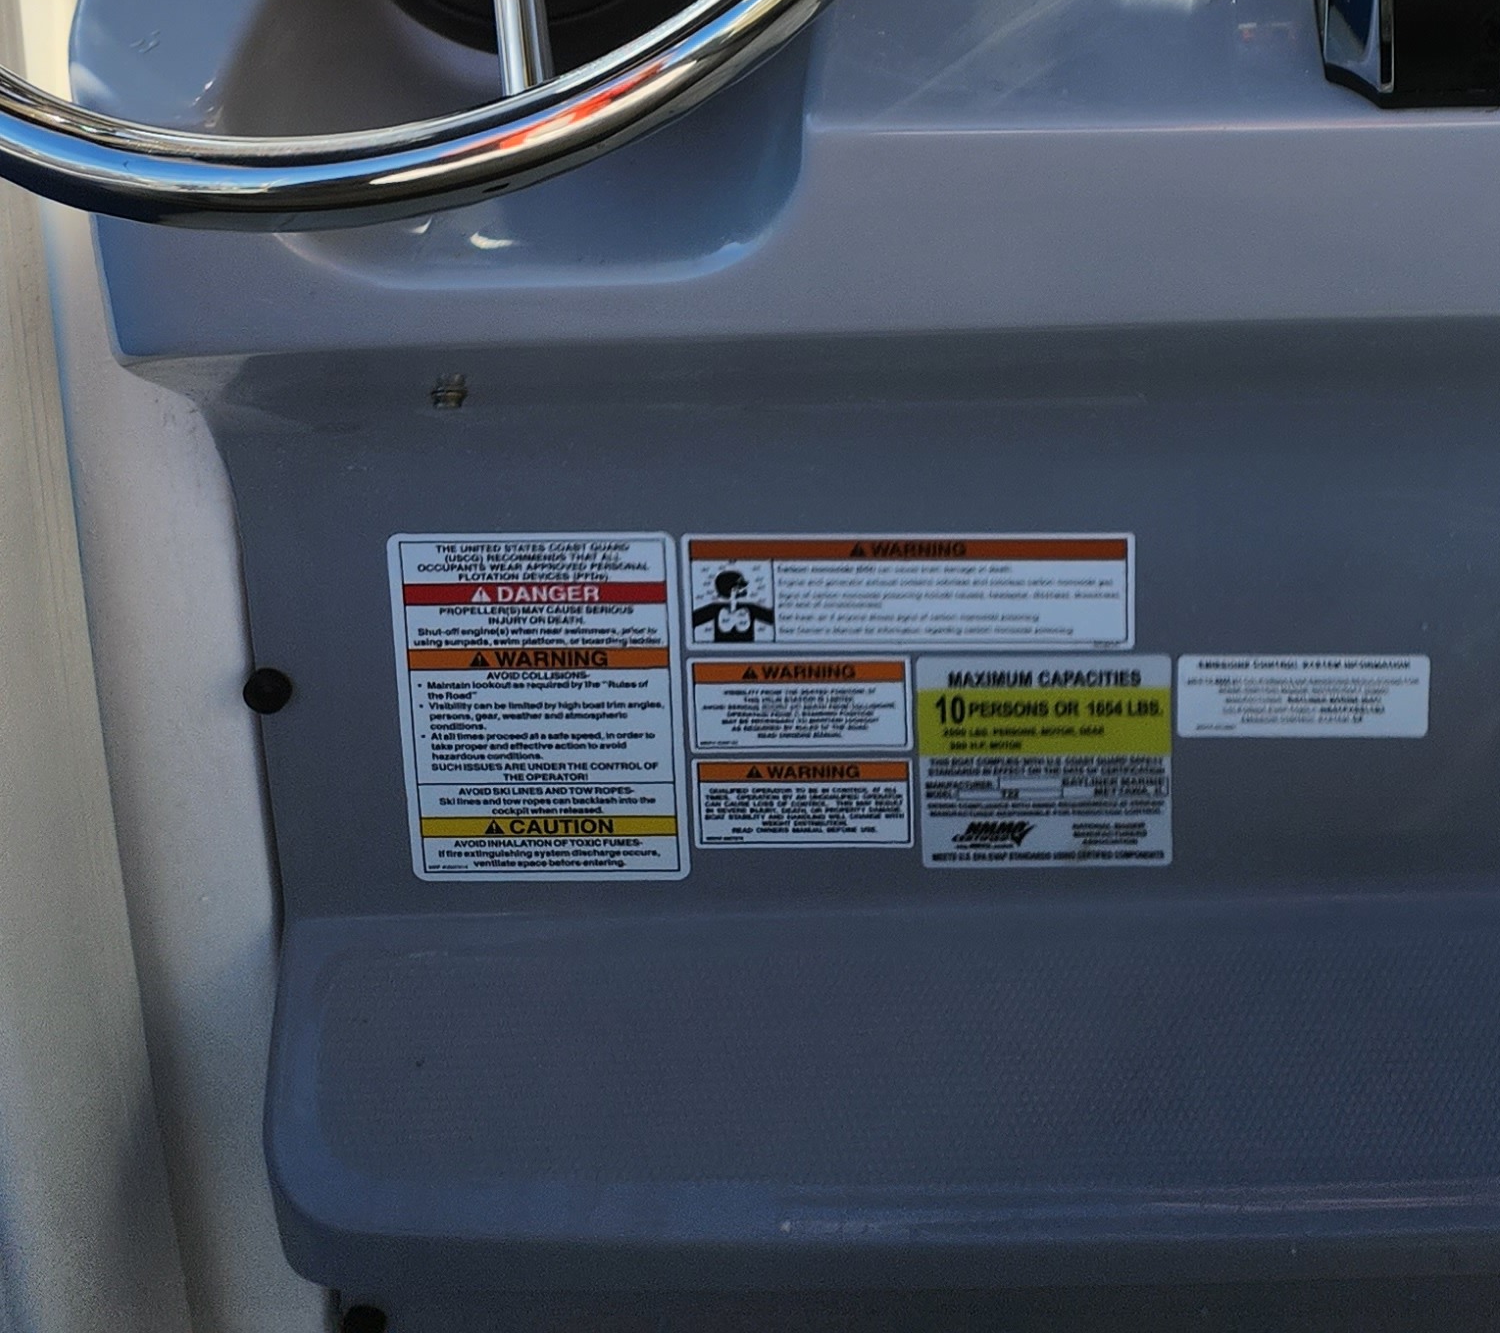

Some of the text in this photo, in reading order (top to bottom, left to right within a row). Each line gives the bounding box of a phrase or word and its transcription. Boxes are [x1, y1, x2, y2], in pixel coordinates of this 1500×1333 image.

[436, 545, 457, 553] THE
[459, 545, 501, 553] UNITED
[872, 542, 966, 557] WARNING
[497, 586, 600, 603] DANGER
[522, 607, 544, 615] MAY
[546, 606, 583, 615] CAUSE
[488, 616, 527, 625] INJURY
[495, 651, 608, 668] WARNING
[762, 665, 856, 680] WARNING
[947, 669, 1142, 688] MAXIMUM CAPACITIES
[936, 694, 966, 724] 10
[968, 700, 1050, 718] PERSONS
[1054, 700, 1079, 717] OR
[1128, 699, 1164, 717] LBS.
[432, 763, 461, 771] SUCH
[527, 762, 566, 770] UNDER
[567, 762, 588, 770] THE
[590, 762, 642, 770] CONTROL
[643, 762, 659, 770] OF
[767, 765, 861, 780] WARNING
[503, 773, 524, 781] THE
[459, 787, 491, 795] AVOID
[492, 787, 510, 795] SKI
[512, 787, 543, 795] LINES
[544, 787, 567, 795] AND
[510, 819, 614, 835] CAUTION
[553, 839, 568, 847] OF
[569, 839, 601, 847] TOXIC
